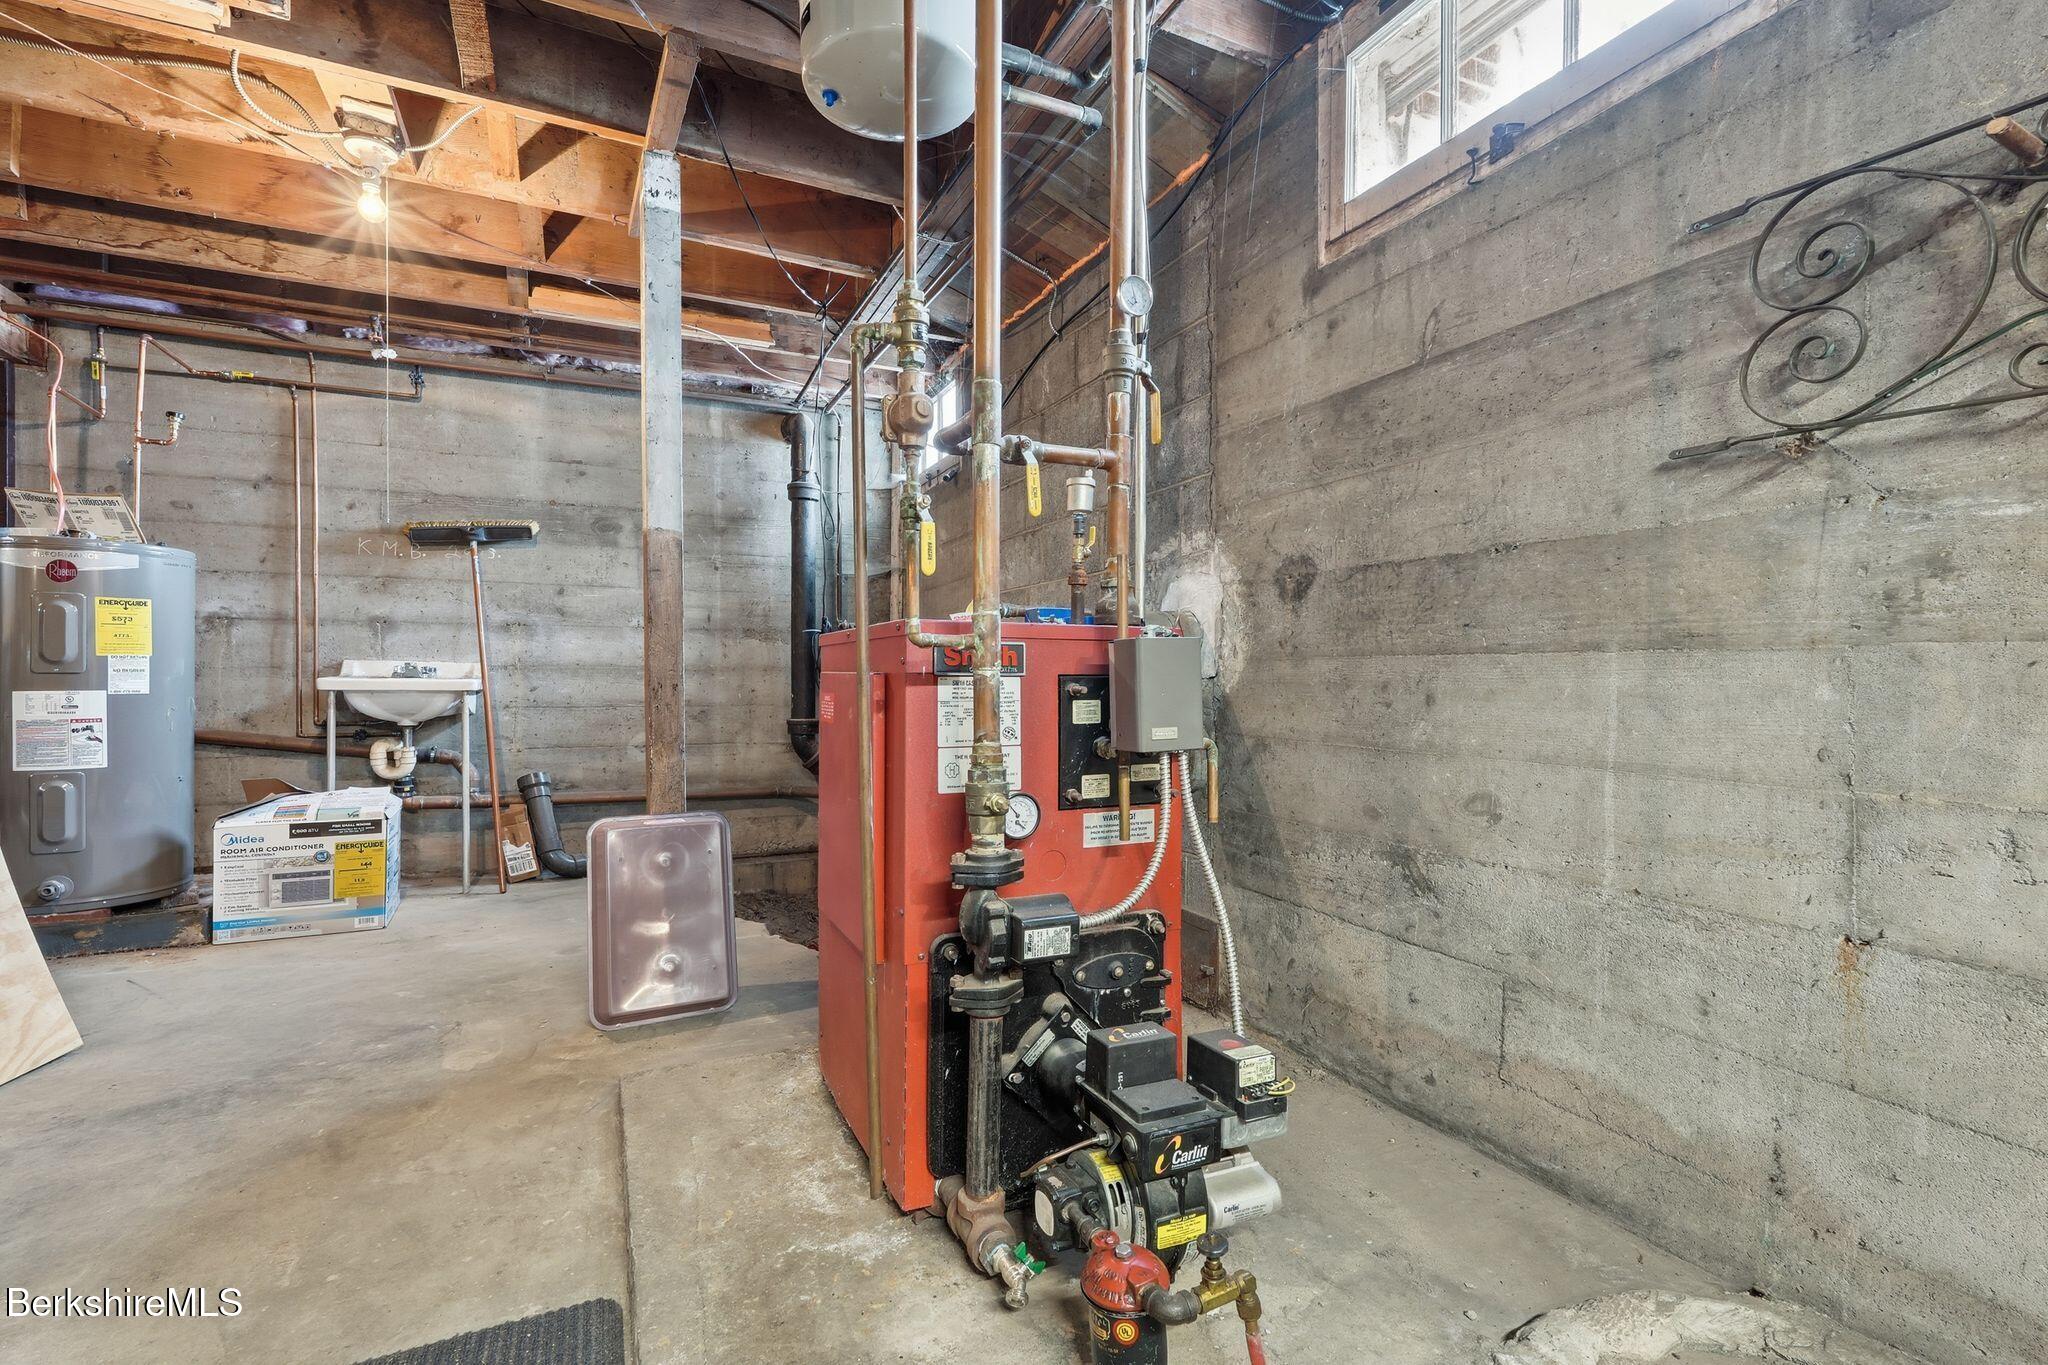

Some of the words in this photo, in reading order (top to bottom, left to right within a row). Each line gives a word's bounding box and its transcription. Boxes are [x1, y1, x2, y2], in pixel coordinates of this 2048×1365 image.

[48, 561, 77, 579] Rheem
[1102, 813, 1136, 822] WARG!
[225, 834, 264, 845] Midea
[249, 845, 263, 853] AIR
[266, 843, 324, 852] CONDITIONER
[1122, 1028, 1158, 1039] Carlin
[1171, 1144, 1208, 1165] Carlin
